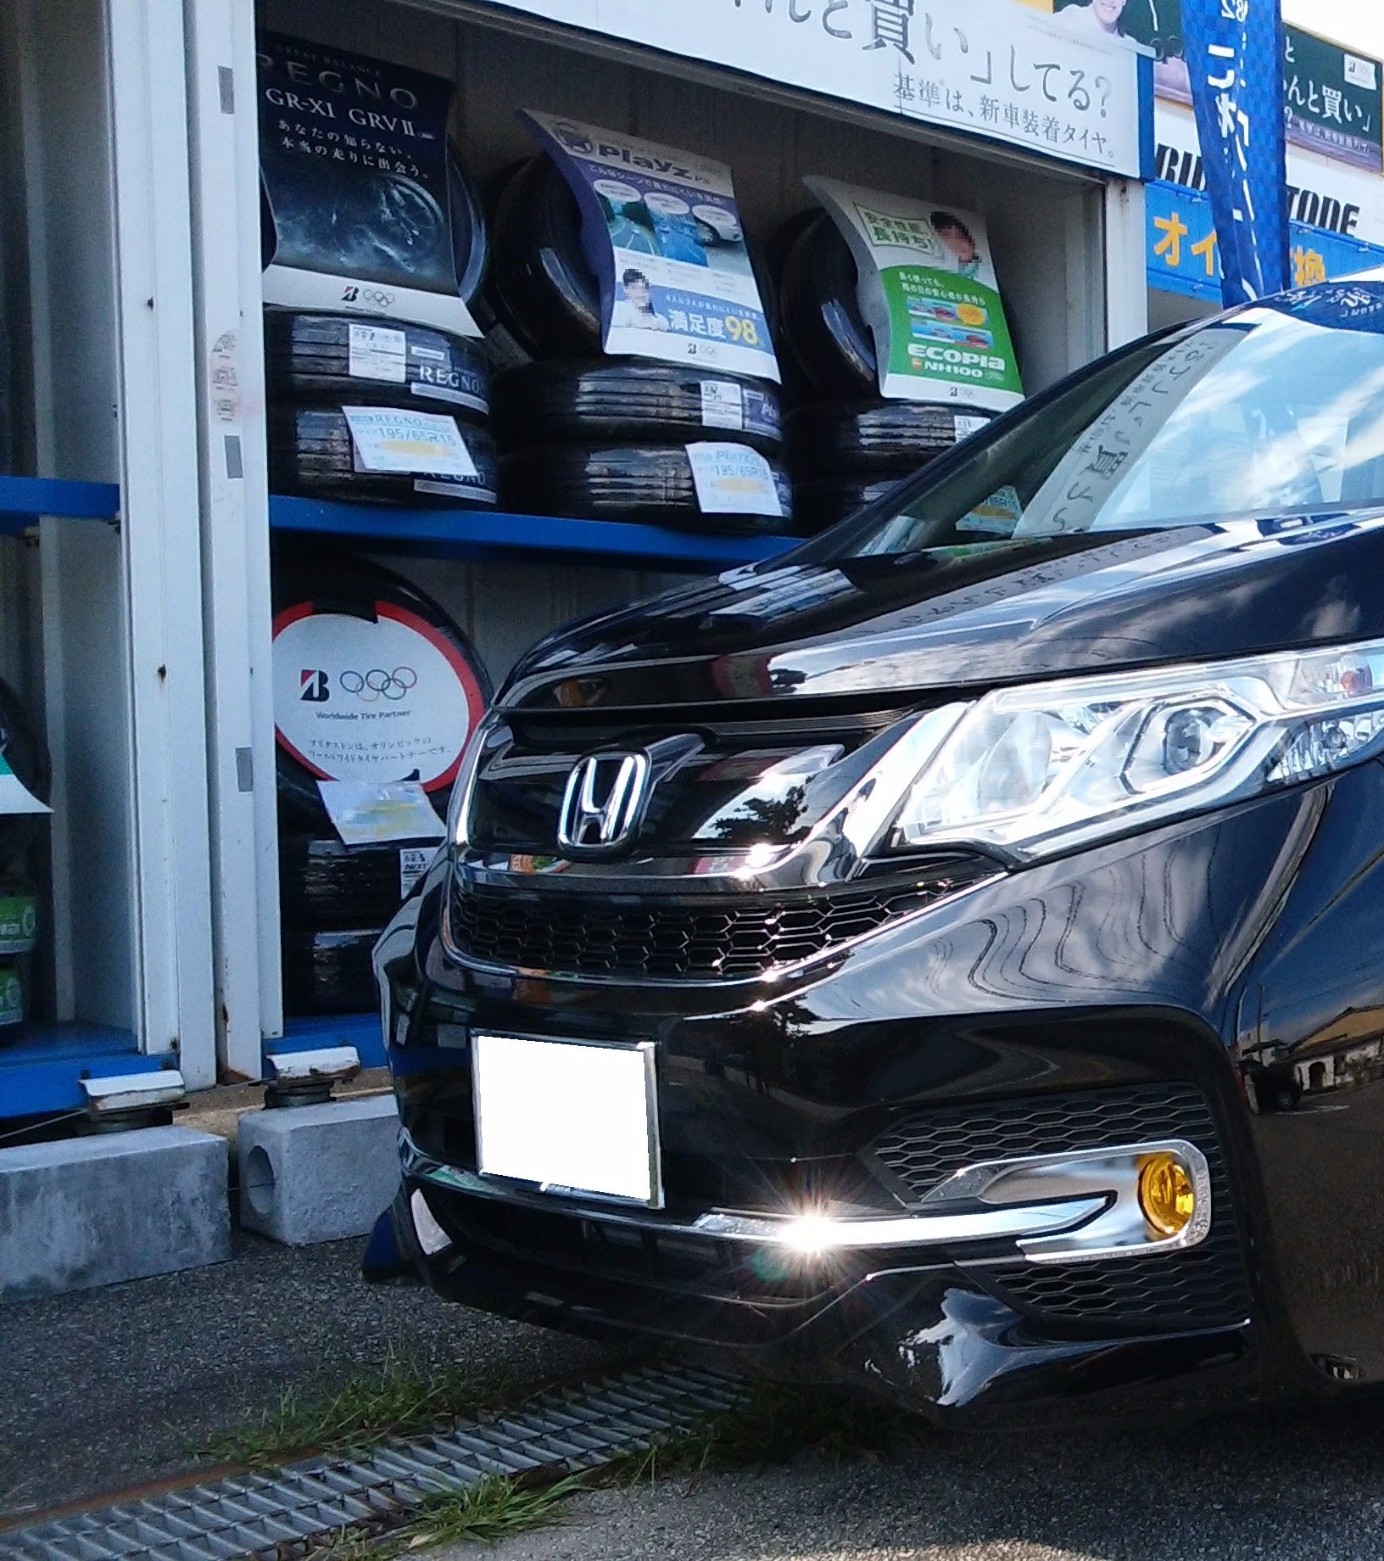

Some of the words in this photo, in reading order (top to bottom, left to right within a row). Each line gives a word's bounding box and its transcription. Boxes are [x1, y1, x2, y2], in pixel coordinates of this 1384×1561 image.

[265, 88, 336, 119] GR-XI
[892, 73, 1115, 158] 基準は、新車装着タイヤ。
[281, 137, 429, 180] 本当の走りに出会う。
[599, 147, 692, 181] Playz
[419, 364, 480, 393] REGNO
[316, 711, 359, 720] Worldwide
[360, 712, 377, 720] Tire
[378, 709, 411, 719] Partner
